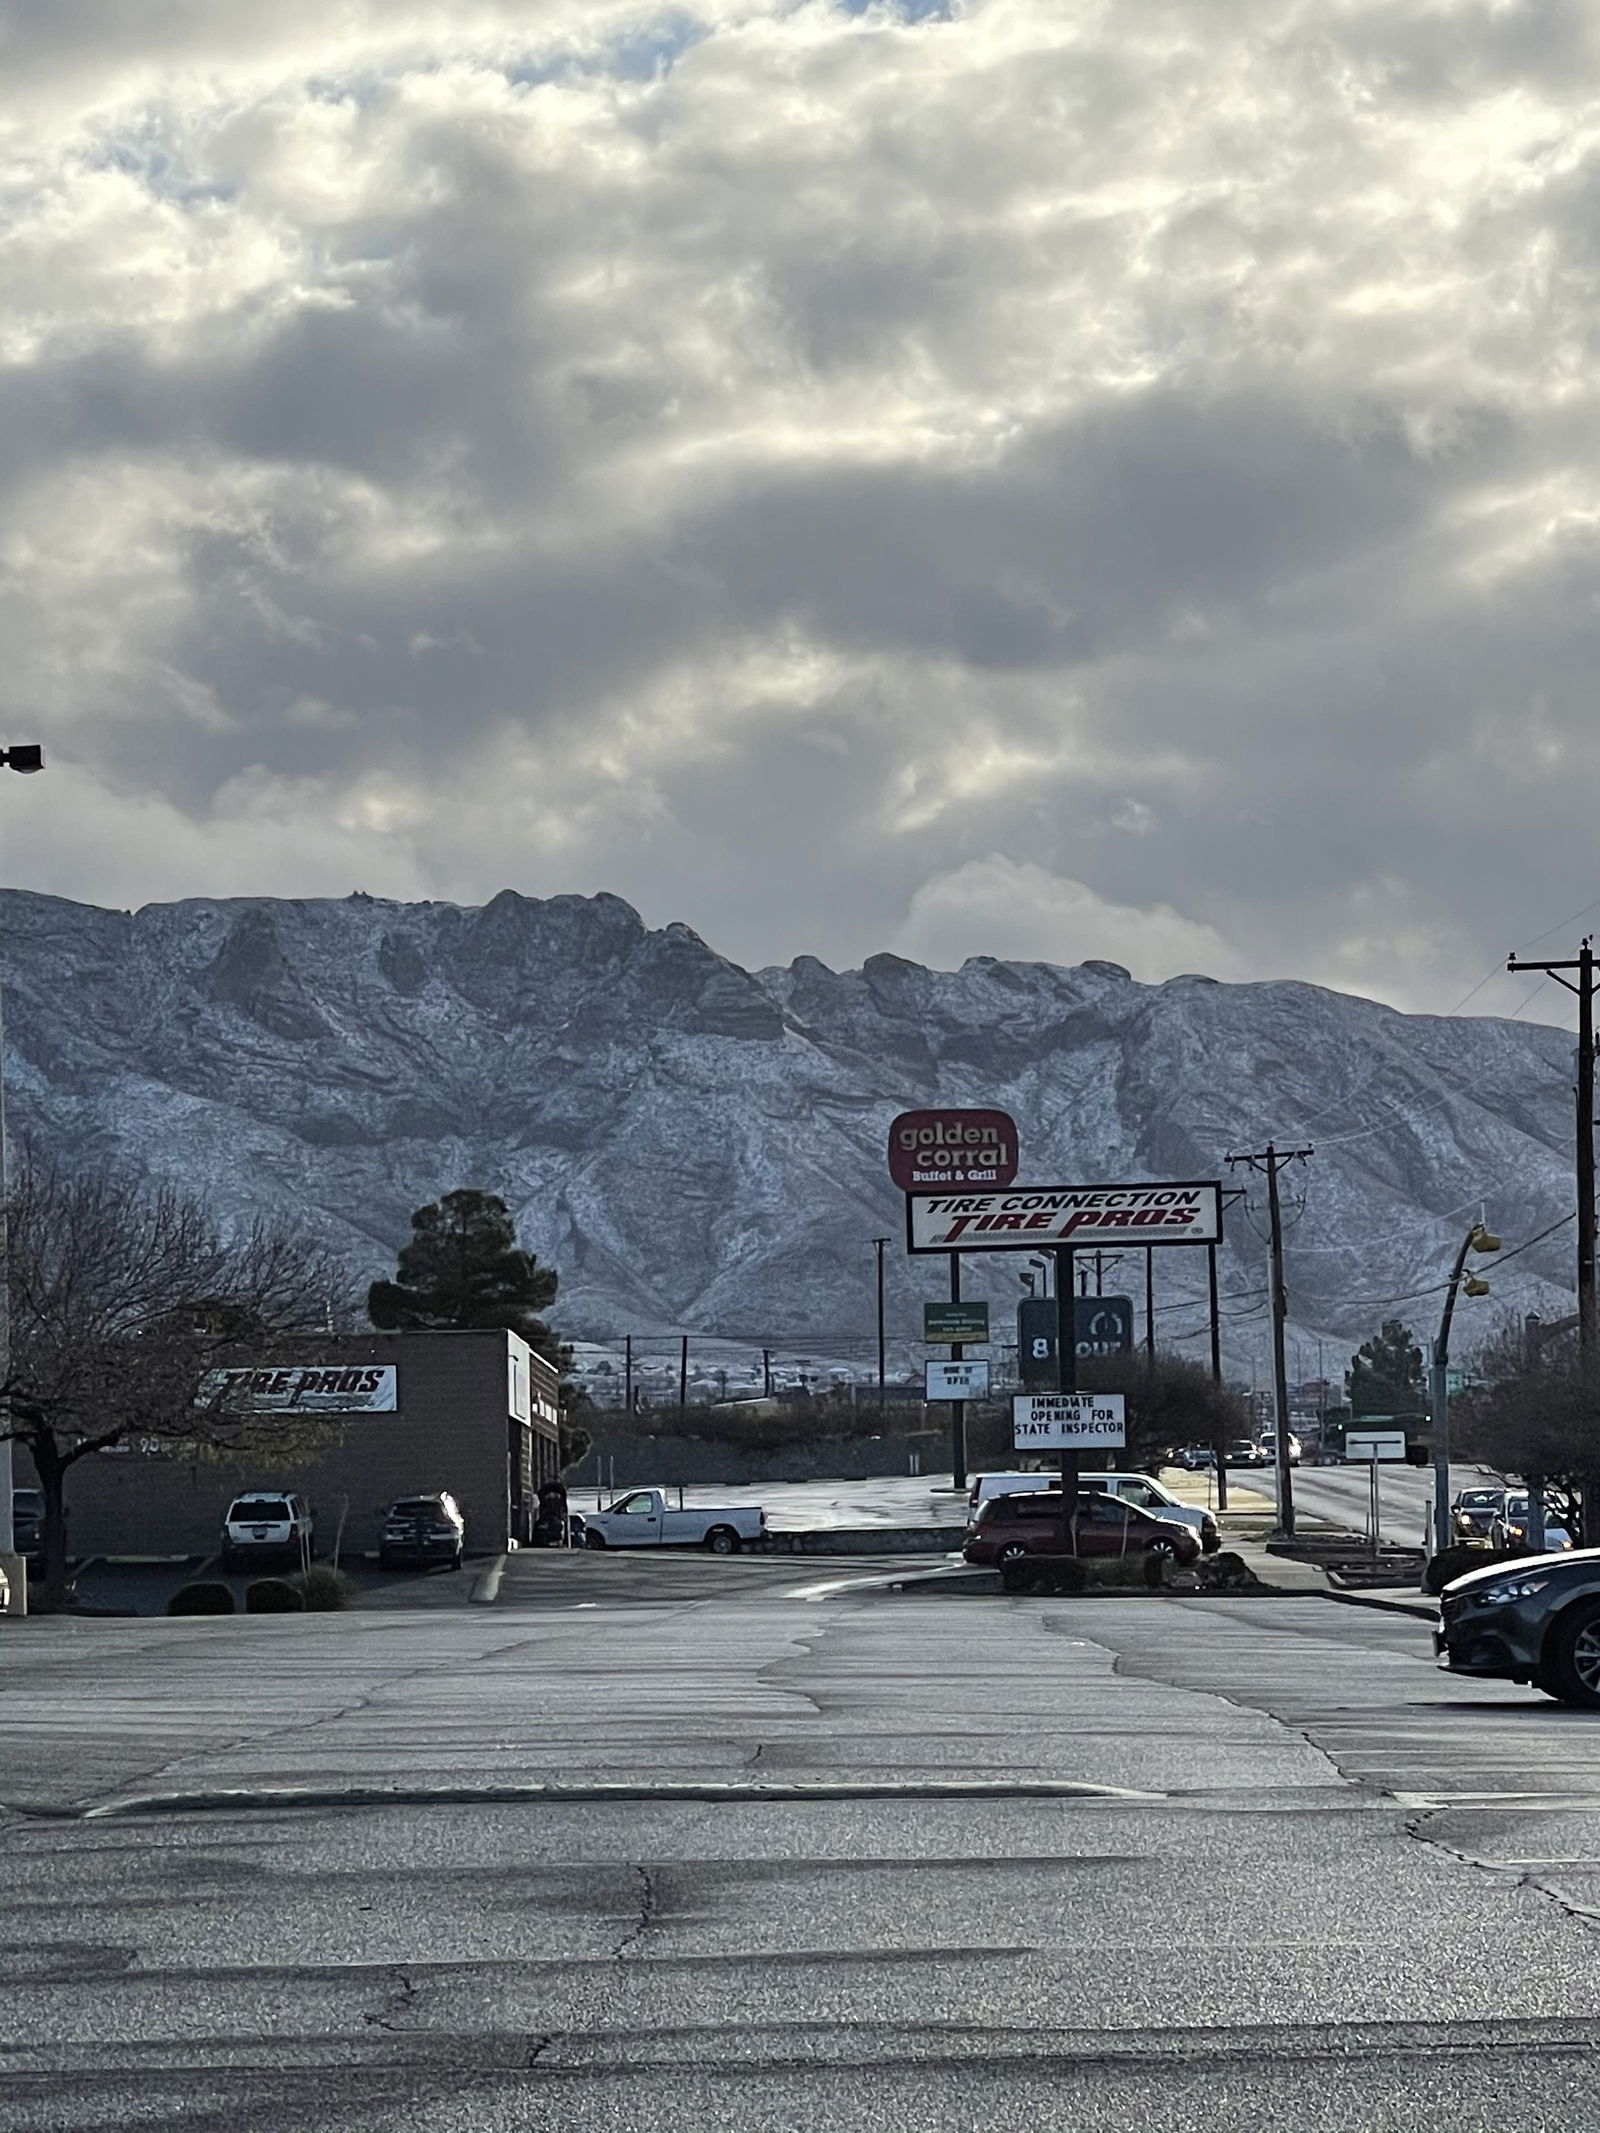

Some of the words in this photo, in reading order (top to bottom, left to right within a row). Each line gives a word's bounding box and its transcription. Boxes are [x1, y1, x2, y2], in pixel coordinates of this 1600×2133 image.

[899, 1121, 999, 1152] golden
[916, 1143, 1009, 1167] corral
[912, 1170, 952, 1182] Buffet
[954, 1168, 965, 1181] &
[967, 1169, 998, 1181] Grill
[926, 1197, 997, 1214] TIRE
[1000, 1190, 1201, 1211] CONNECTION
[942, 1212, 1058, 1243] TIRE
[1056, 1207, 1201, 1239] PROS
[288, 1370, 386, 1407] PROS
[1031, 1396, 1095, 1409] IMMEDIATE
[1030, 1410, 1081, 1422] OPENING
[1091, 1409, 1114, 1421] FOR
[1014, 1423, 1051, 1435] STATE
[1061, 1422, 1124, 1434] INSPECTOR
